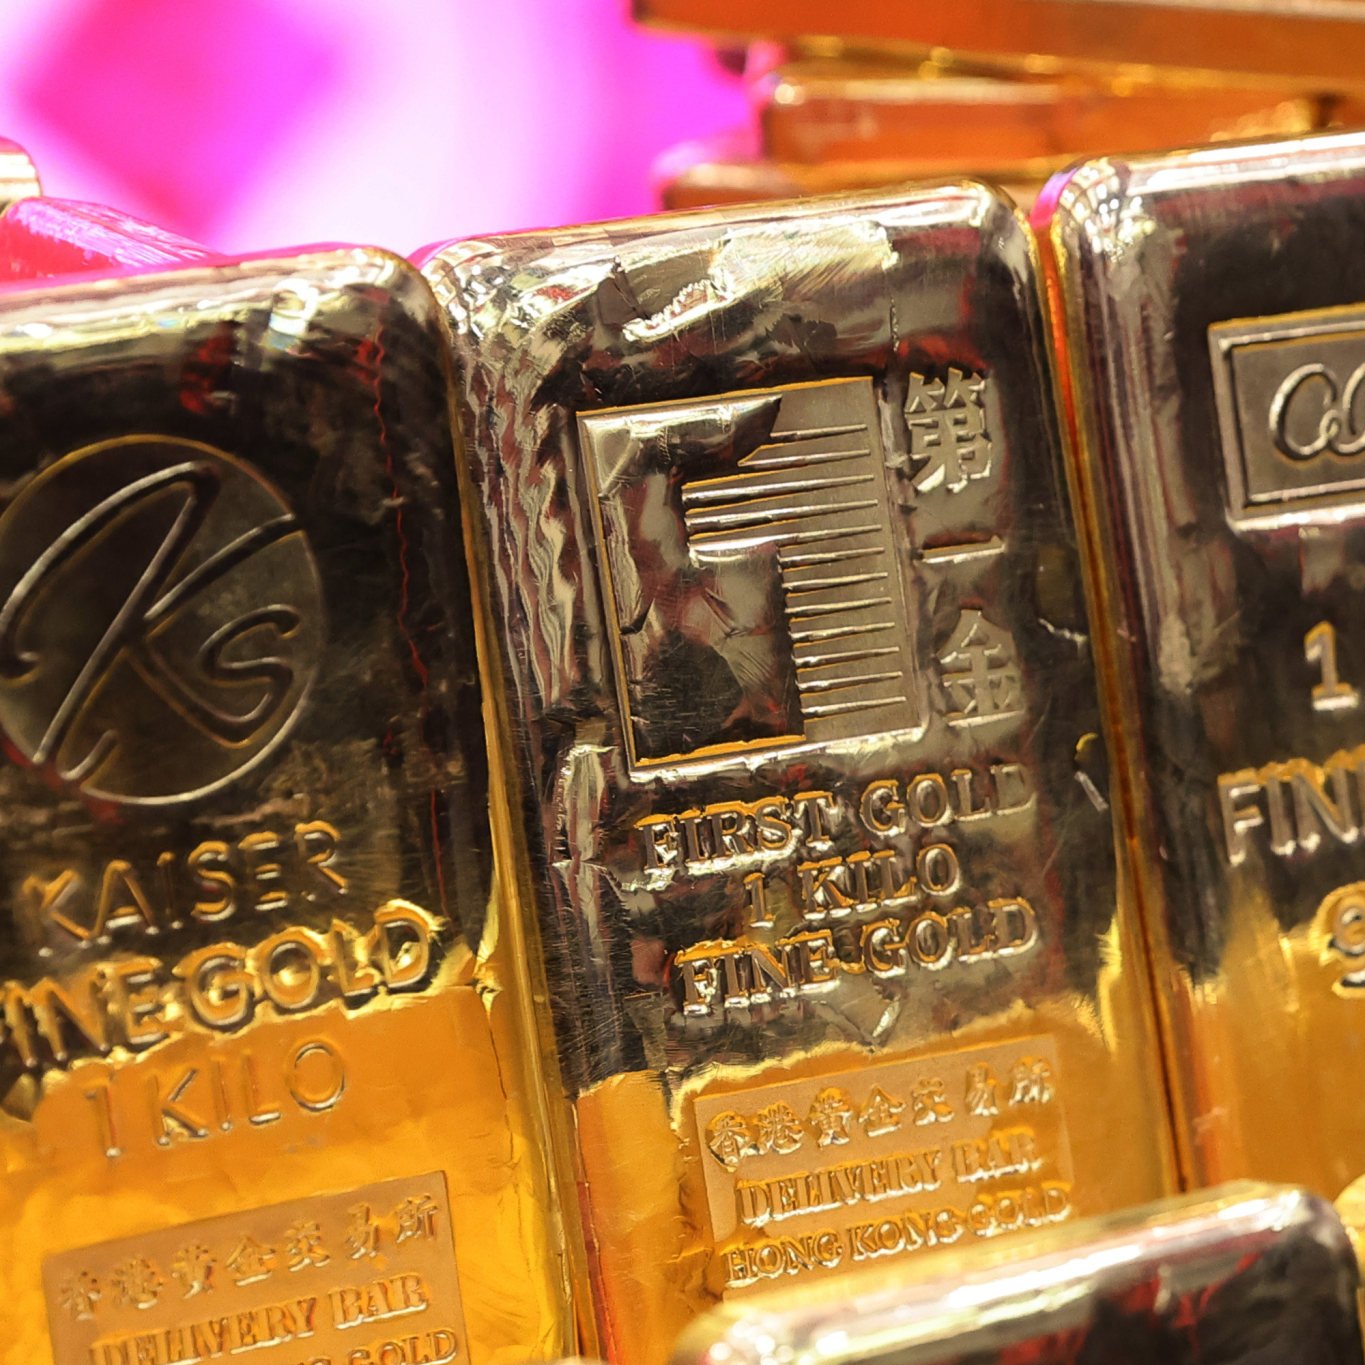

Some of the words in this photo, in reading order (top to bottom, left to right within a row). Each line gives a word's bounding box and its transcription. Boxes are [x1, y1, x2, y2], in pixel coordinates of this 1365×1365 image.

[1305, 621, 1359, 711] 1
[633, 789, 840, 882] FIRST
[860, 764, 1038, 838] GOLD
[22, 819, 349, 957] KAISER
[743, 872, 776, 929] 1
[797, 843, 966, 920] KILO
[0, 955, 172, 1069] INE
[172, 899, 440, 1030] GOLD
[672, 929, 842, 1017] FINE
[860, 897, 1043, 979] GOLD
[83, 1076, 123, 1158] 1
[147, 1038, 348, 1148] KILO
[735, 1148, 942, 1228] DELIVERY
[951, 1124, 1047, 1183] BAR
[721, 1227, 843, 1289] HONG
[848, 1206, 967, 1260] KONG
[967, 1181, 1073, 1237] GOLD
[329, 1271, 428, 1331] BAR
